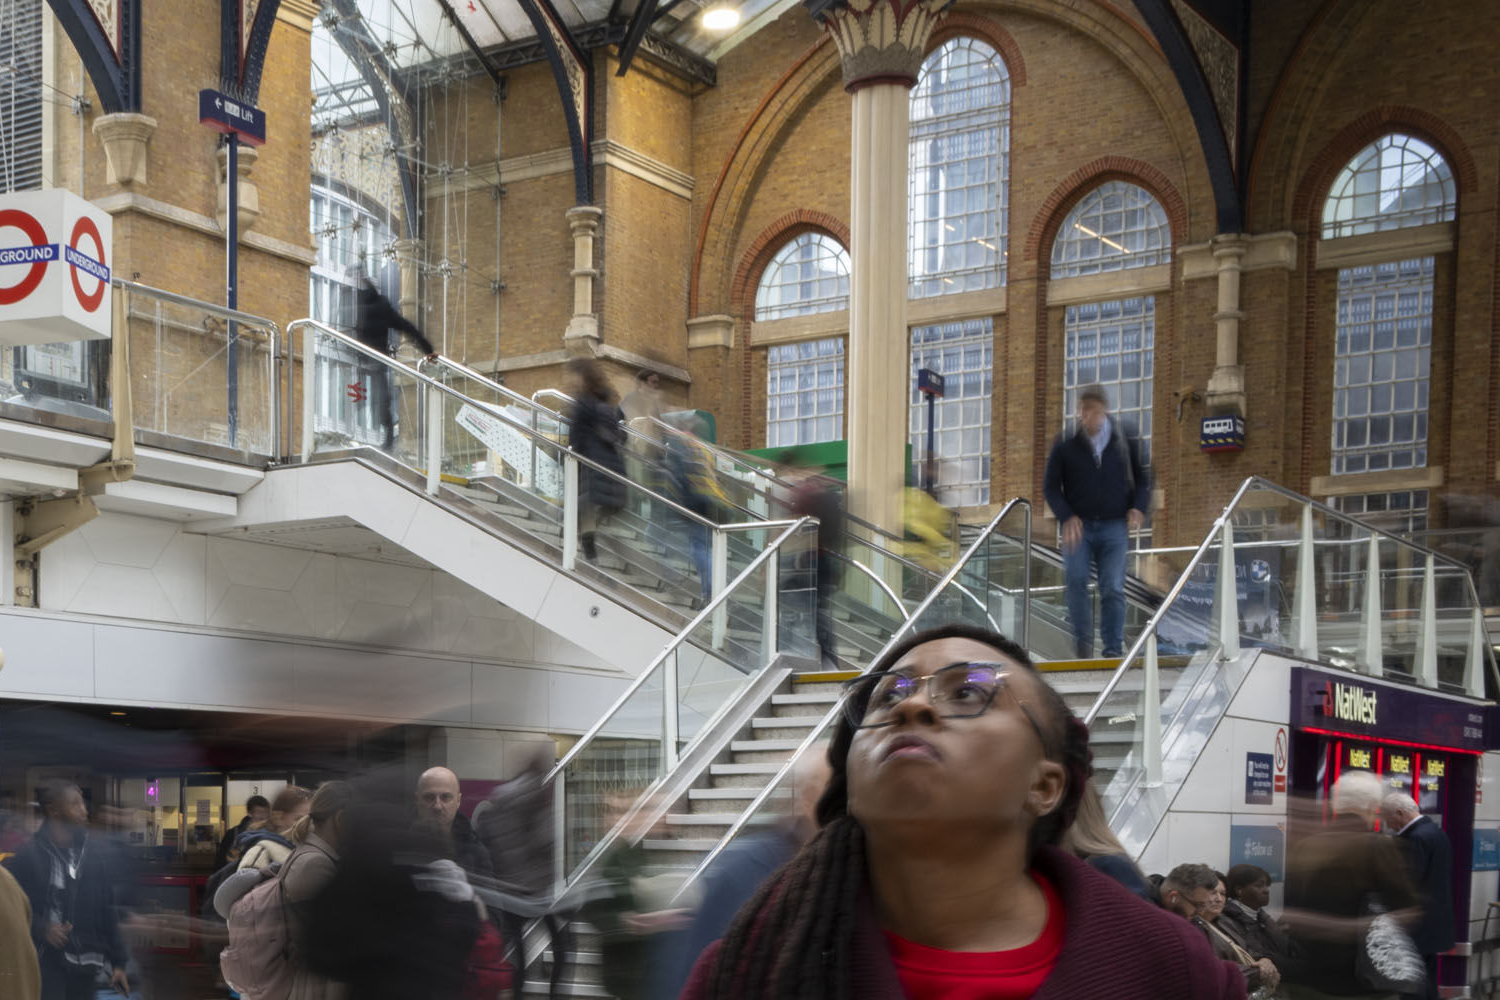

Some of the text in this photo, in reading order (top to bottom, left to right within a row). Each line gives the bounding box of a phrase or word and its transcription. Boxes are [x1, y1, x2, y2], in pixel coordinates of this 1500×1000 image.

[241, 107, 254, 124] Lift
[67, 249, 108, 281] UNDERGROUND
[1335, 682, 1378, 725] NatWest
[253, 786, 259, 795] 3
